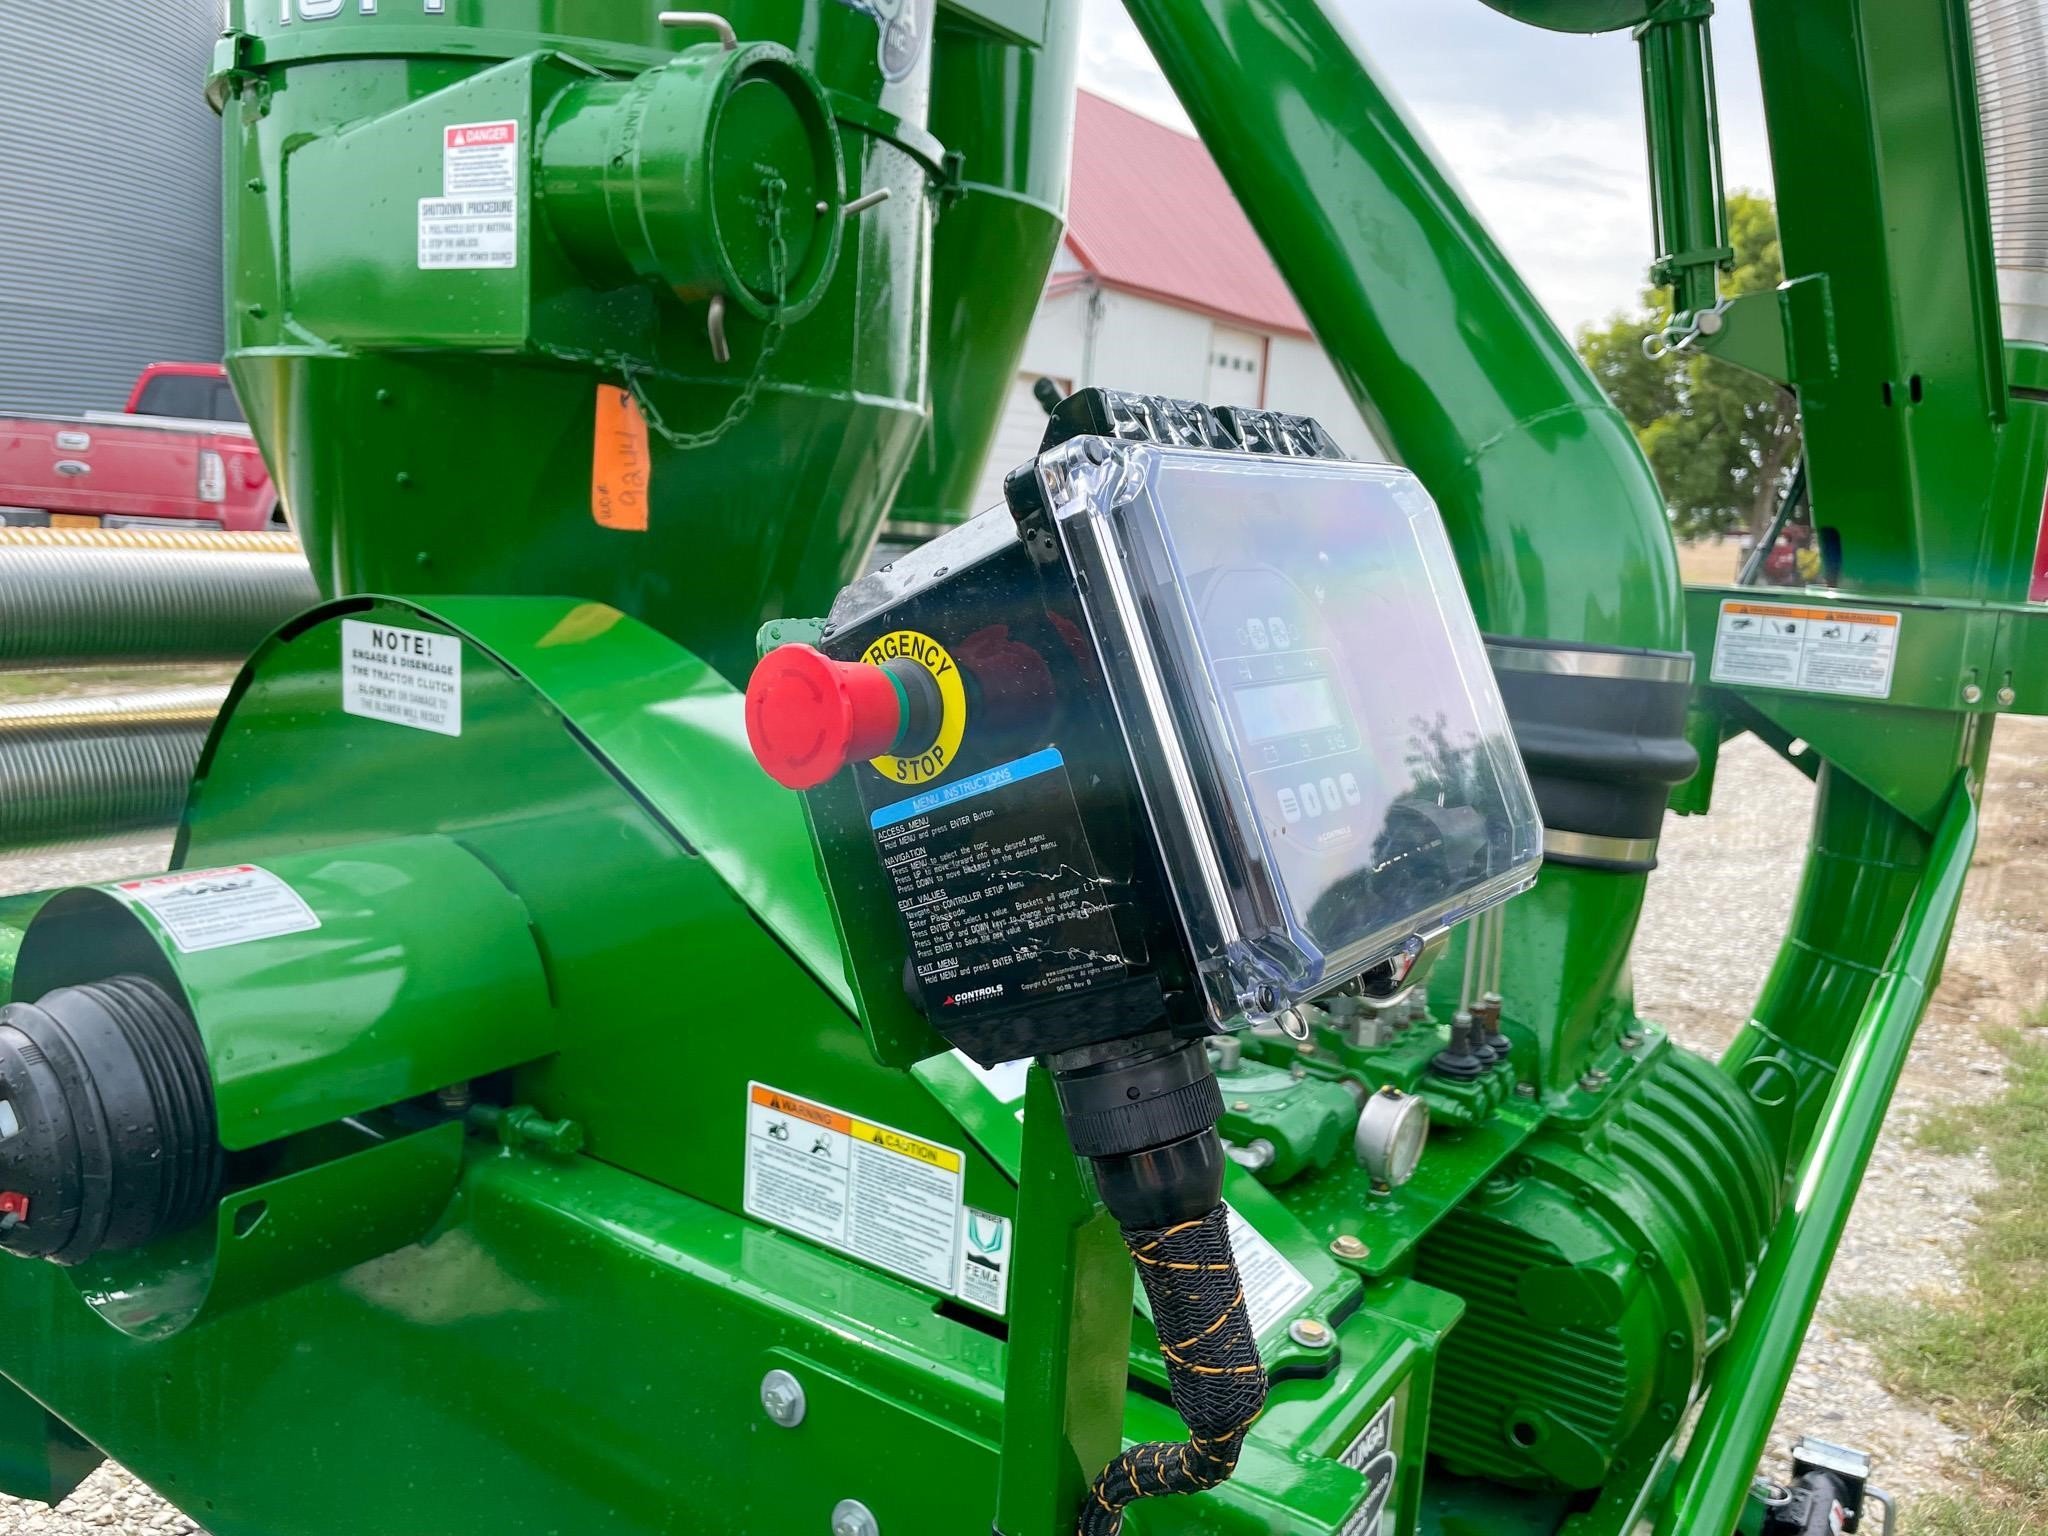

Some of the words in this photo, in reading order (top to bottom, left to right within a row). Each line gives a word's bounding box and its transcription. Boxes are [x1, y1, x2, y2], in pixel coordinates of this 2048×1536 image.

[466, 127, 508, 142] DANGER
[372, 630, 432, 657] NOTE!
[864, 635, 952, 677] RGENCY
[352, 648, 388, 664] ENGAGE
[400, 657, 454, 676] DISENGAGE
[353, 665, 369, 677] THE
[372, 669, 414, 686] TRACTOR
[418, 678, 454, 694] CLUTCH
[896, 746, 944, 780] STOP
[912, 793, 940, 811] MENU
[943, 767, 1012, 800] INSTRUCTIONS
[877, 824, 906, 841] ACCESS
[908, 816, 930, 830] MENU
[884, 840, 898, 851] Hold
[899, 833, 917, 846] MENU
[918, 830, 930, 840] and
[931, 824, 949, 837] press
[949, 815, 971, 829] ENTER
[884, 846, 927, 867] NAVIGATION
[892, 865, 910, 877] Press
[910, 859, 929, 871] MENU
[930, 856, 938, 865] to
[939, 850, 959, 862] select
[960, 846, 972, 856] the
[894, 874, 912, 886] Press
[913, 870, 923, 880] UP
[924, 867, 932, 877] to
[934, 863, 950, 874] move
[951, 854, 975, 868] forward
[990, 846, 1002, 856] the
[1004, 838, 1028, 852] desired
[897, 883, 915, 895] Press
[916, 877, 935, 889] DOWN
[936, 874, 944, 883] to
[946, 870, 962, 880] move
[1001, 853, 1013, 863] the
[1015, 845, 1039, 859] desired
[897, 898, 915, 910] EDIT
[917, 888, 947, 904] VALUES
[905, 906, 932, 922] Navigate
[933, 904, 941, 912] to
[942, 891, 983, 910] CONTROLLER
[984, 884, 1006, 898] SETUP
[1007, 879, 1025, 891] Menu
[911, 928, 929, 939] Press
[929, 921, 951, 935] ENTER
[953, 919, 961, 928] to
[962, 913, 982, 926] select
[1015, 896, 1044, 911] Brackets
[1058, 887, 1082, 901] appear
[909, 917, 928, 930] Enter
[914, 937, 932, 949] Press
[933, 934, 945, 944] the
[946, 931, 956, 941] UP
[957, 927, 970, 938] and
[970, 922, 990, 934] DOWN
[991, 918, 1008, 930] keys
[1019, 908, 1043, 922] change
[1044, 904, 1056, 915] the
[917, 948, 934, 959] Press
[934, 942, 954, 955] ENTER
[955, 940, 963, 949] to
[964, 936, 979, 947] Save
[917, 963, 934, 975] EXIT
[937, 957, 960, 969] MENU
[924, 974, 939, 985] Hold
[939, 969, 959, 981] MENU
[959, 966, 971, 976] and
[973, 962, 991, 975] press
[992, 955, 1014, 968] ENTER
[954, 984, 1004, 1002] CONTROLS
[781, 1098, 833, 1127] WARNING
[885, 1134, 938, 1163] CAUTION
[966, 1264, 999, 1284] FEMA
